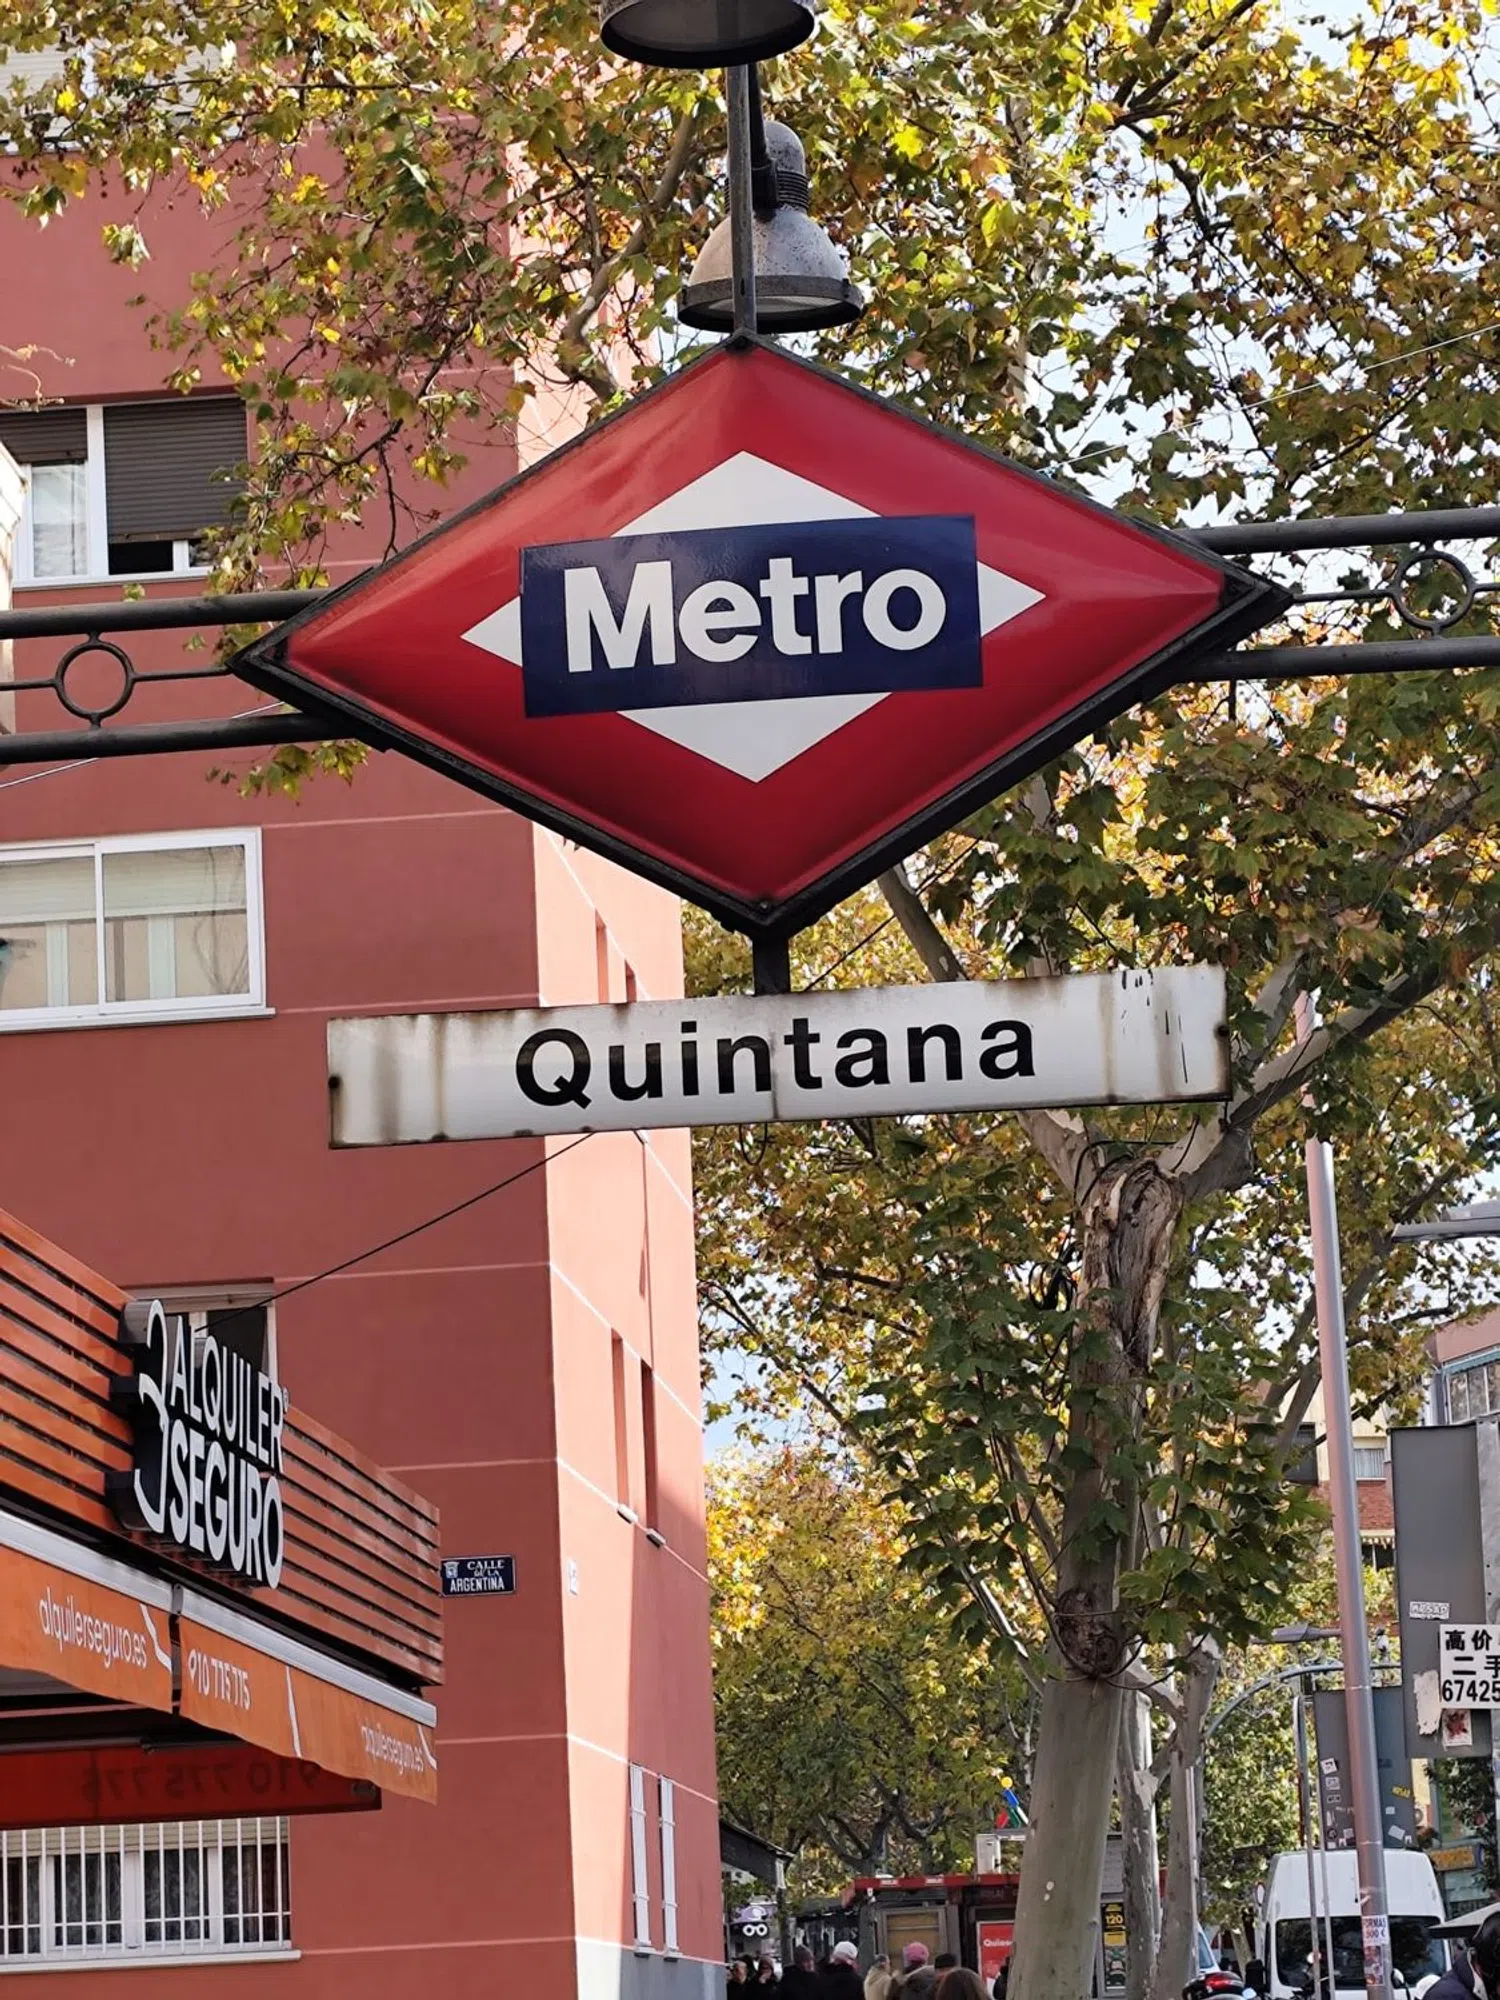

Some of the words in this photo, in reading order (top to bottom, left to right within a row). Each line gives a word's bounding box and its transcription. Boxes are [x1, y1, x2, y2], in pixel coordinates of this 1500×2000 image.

[564, 558, 946, 673] Metro
[516, 1018, 1035, 1109] Quintana
[170, 1315, 284, 1473] ALQUILER
[169, 1419, 284, 1589] SEGURO
[450, 1577, 505, 1593] ARGENTINA
[467, 1559, 505, 1571] CALLE
[39, 1586, 148, 1669] alquilerseguro.es
[188, 1648, 210, 1696] 910
[1442, 1679, 1500, 1702] 67425
